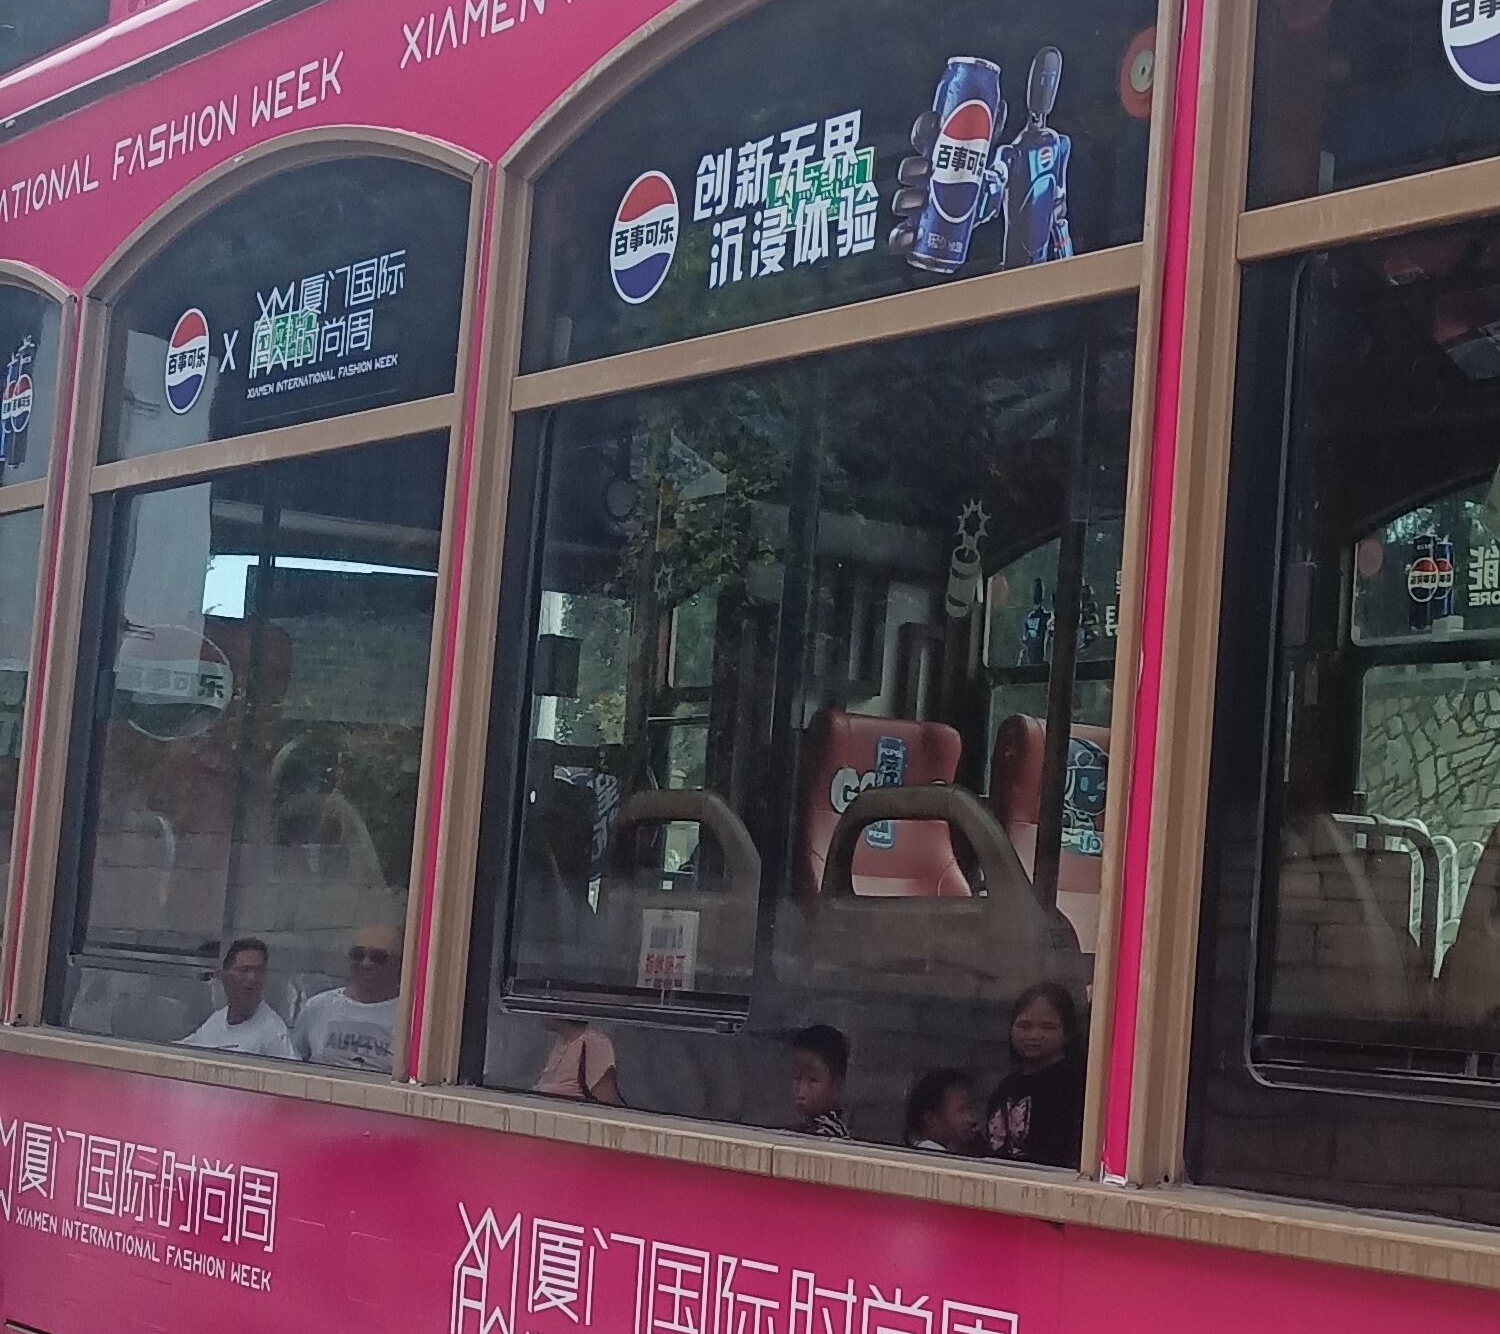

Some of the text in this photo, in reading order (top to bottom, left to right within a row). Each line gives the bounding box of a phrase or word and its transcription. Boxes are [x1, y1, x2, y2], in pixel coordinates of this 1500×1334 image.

[112, 95, 238, 181] FASHION
[251, 50, 344, 127] WEEK
[693, 110, 862, 221] 创新无界
[614, 214, 675, 255] 百事可乐
[708, 183, 880, 290] 沉浸体验
[300, 250, 407, 315] 厦门国际
[168, 347, 206, 375] 百事可乐
[220, 330, 239, 373] X
[294, 308, 374, 368] 时尚周
[247, 353, 399, 399] XIAMEN INTERNATIONAL FASHION WEEK
[18, 1121, 278, 1253] 厦门国际时尚周
[15, 1205, 272, 1292] XIAMEN INTERNATIONAL FASHION WEEK
